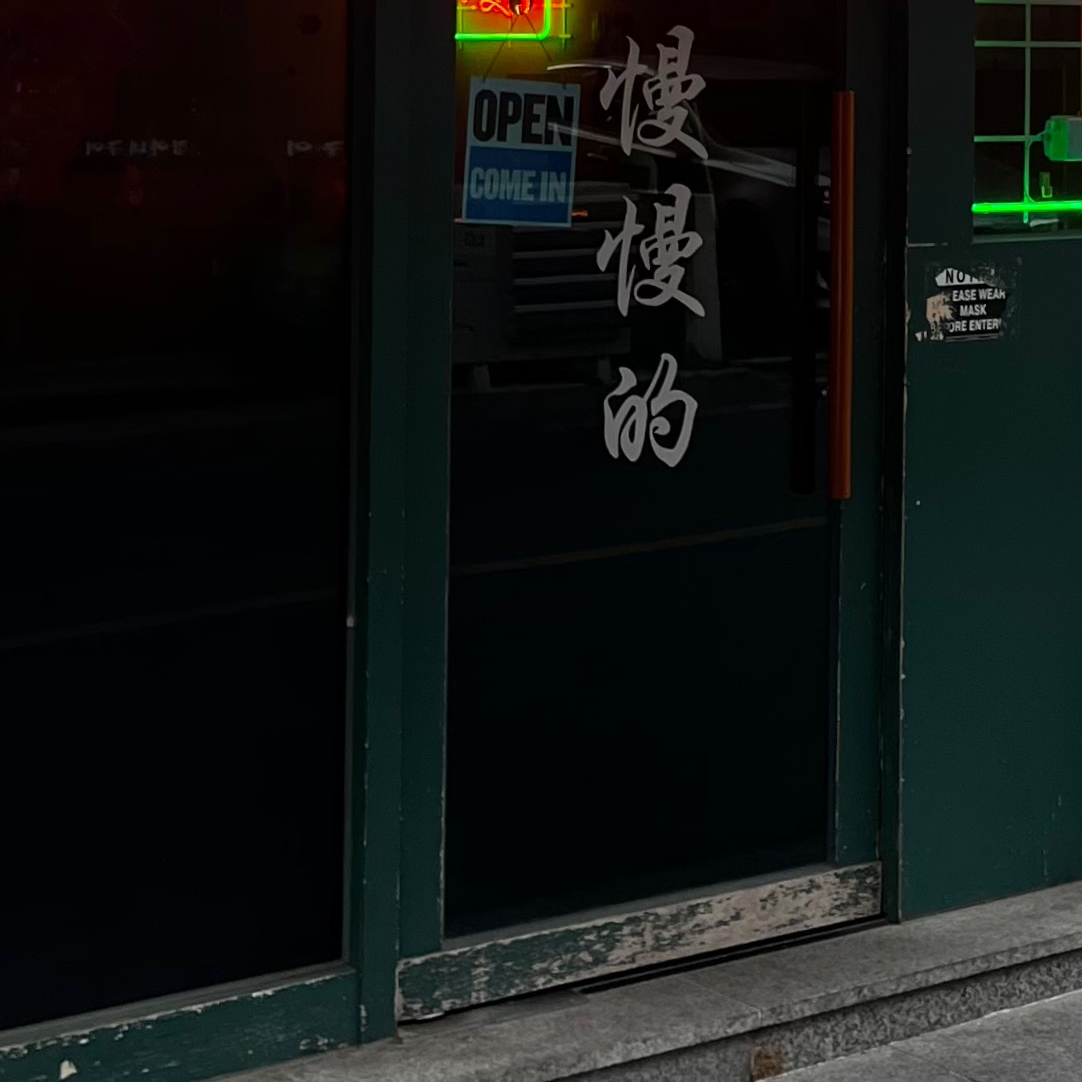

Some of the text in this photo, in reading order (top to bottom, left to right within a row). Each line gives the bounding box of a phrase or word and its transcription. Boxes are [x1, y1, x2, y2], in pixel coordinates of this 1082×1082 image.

[473, 89, 575, 147] OPEN
[470, 167, 567, 203] COME IN
[596, 25, 709, 468] 慢慢的
[952, 288, 977, 302] EASE
[959, 303, 987, 317] MASK
